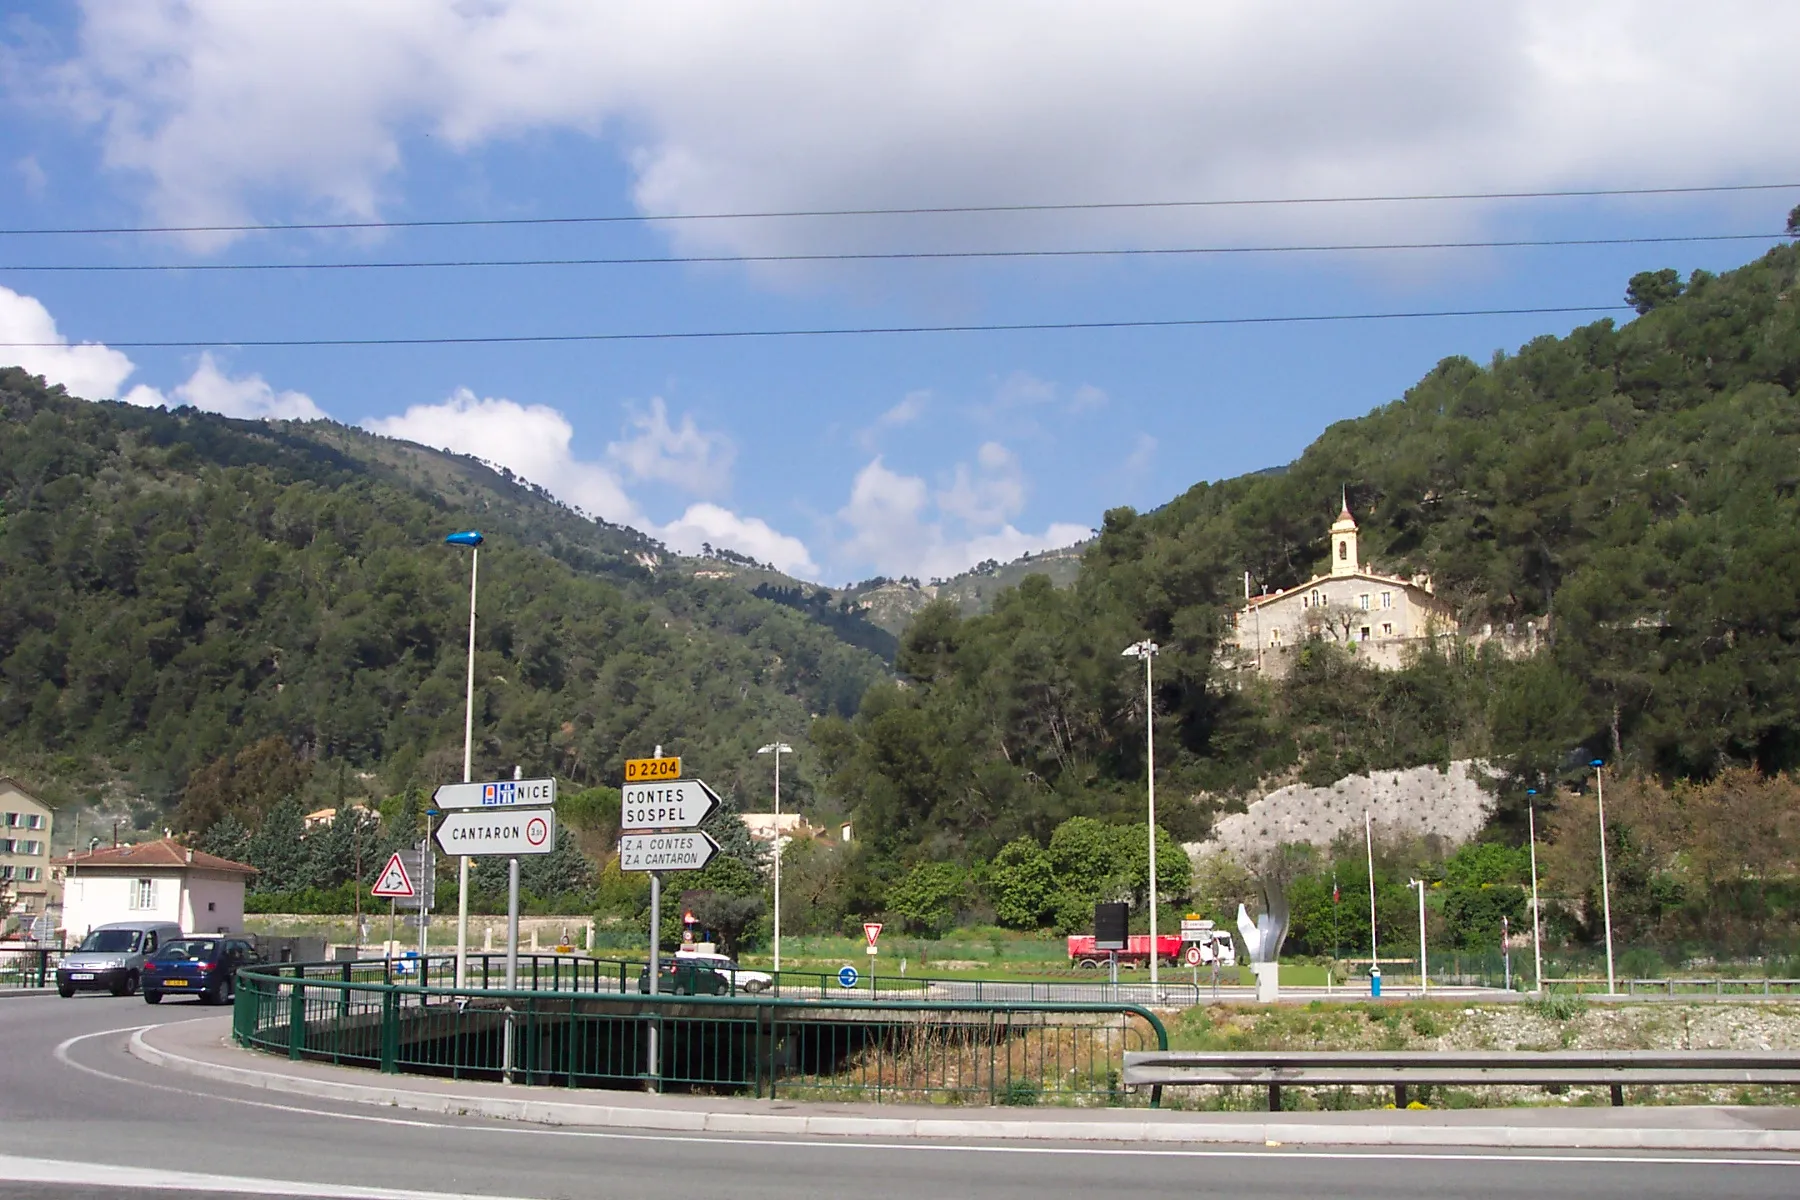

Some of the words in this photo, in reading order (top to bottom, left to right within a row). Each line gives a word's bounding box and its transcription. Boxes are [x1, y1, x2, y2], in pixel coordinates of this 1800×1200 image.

[629, 764, 636, 777] D
[641, 762, 677, 776] 2204
[517, 785, 549, 799] NICE
[627, 789, 684, 804] CONTES
[627, 808, 685, 823] SOSPEL
[452, 826, 519, 840] CANTARON
[649, 838, 694, 850] CONTES
[645, 852, 698, 865] CANTARON
